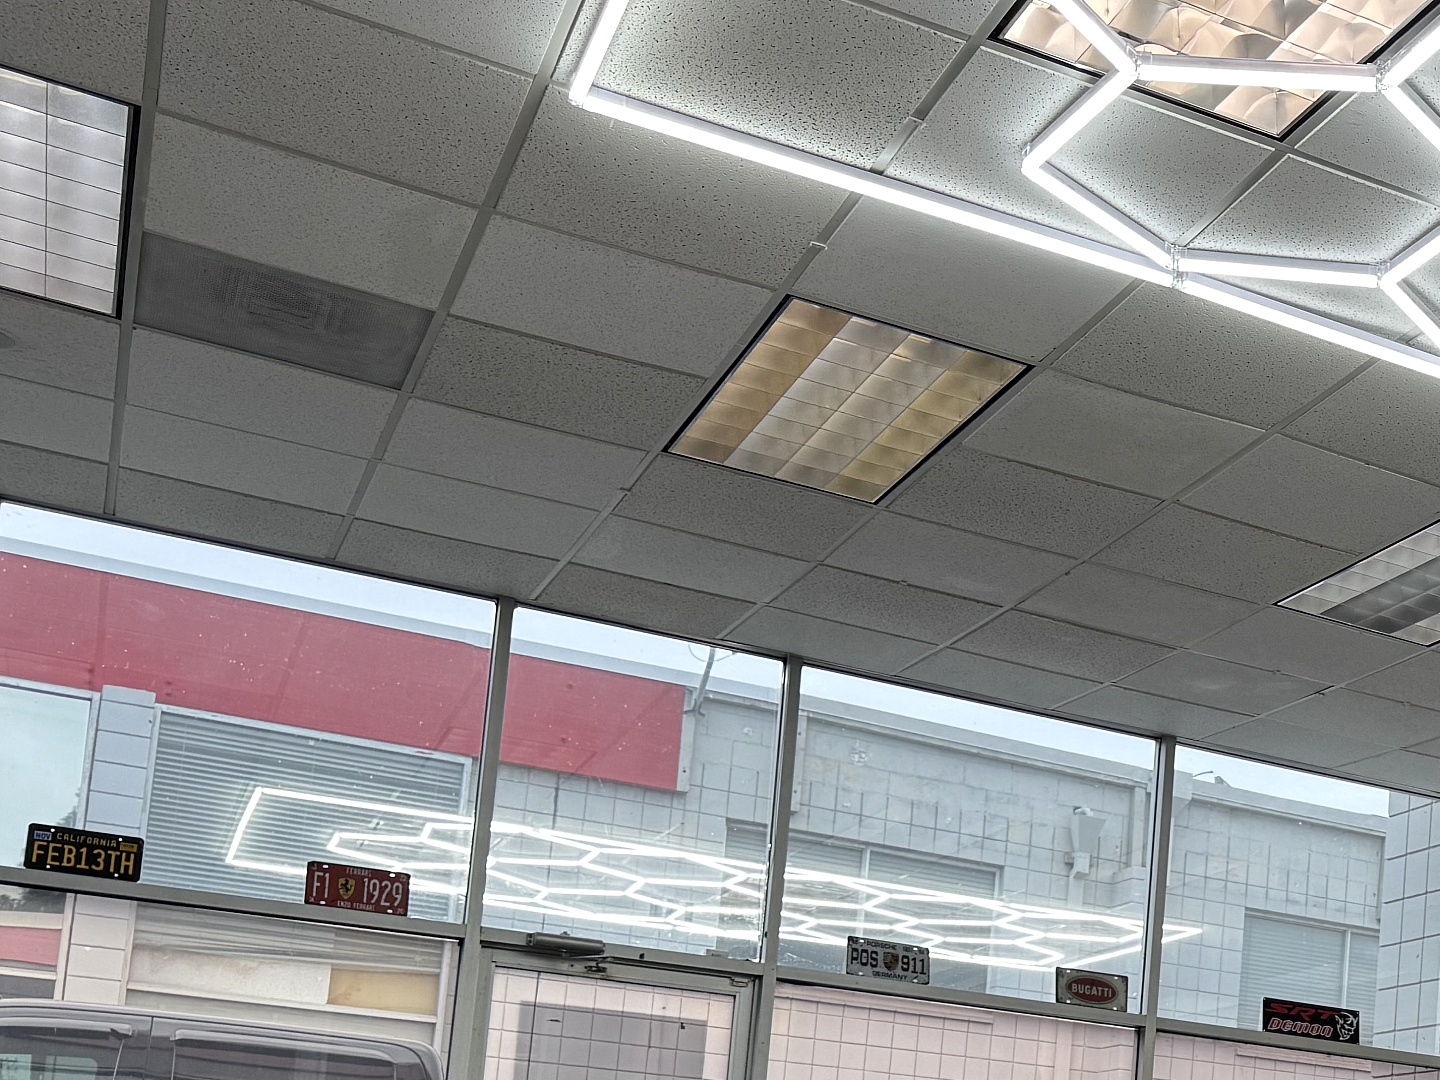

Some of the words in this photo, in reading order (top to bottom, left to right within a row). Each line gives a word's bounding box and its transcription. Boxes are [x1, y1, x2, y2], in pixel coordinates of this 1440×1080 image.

[56, 833, 117, 848] CALIFORNIA
[31, 841, 134, 875] FEB13TH
[346, 867, 372, 877] FERRARI
[312, 872, 330, 899] F1
[363, 878, 403, 907] 1929
[850, 947, 879, 968] POS
[901, 955, 926, 975] 911
[872, 970, 908, 981] GERMANY
[1071, 983, 1112, 998] BUGATTI
[1265, 1003, 1340, 1021] SRT
